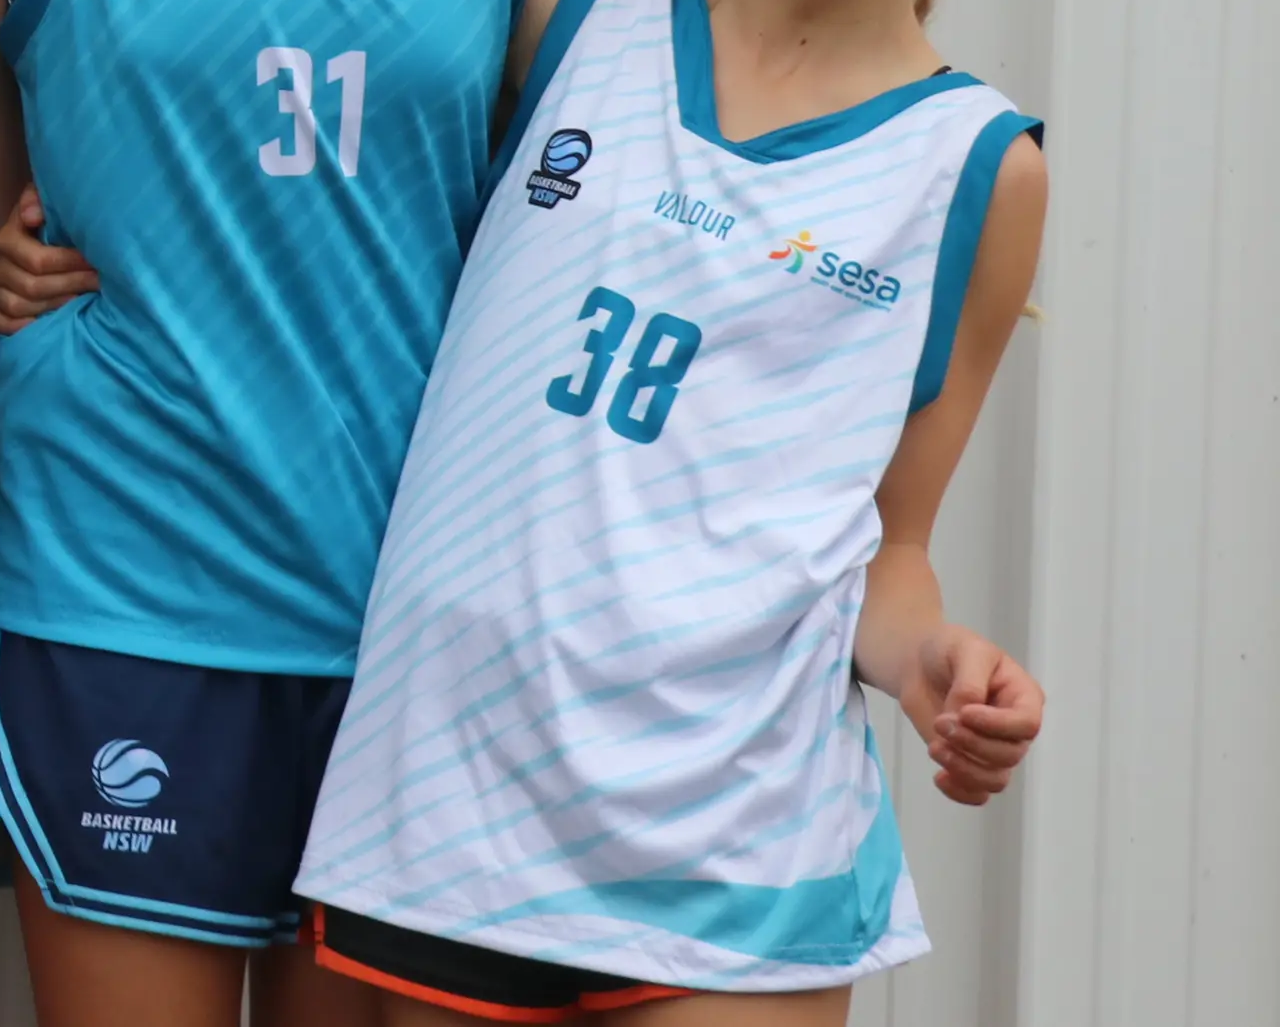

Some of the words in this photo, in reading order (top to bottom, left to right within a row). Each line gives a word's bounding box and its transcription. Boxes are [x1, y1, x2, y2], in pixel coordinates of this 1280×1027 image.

[256, 46, 367, 177] 31
[653, 190, 736, 241] VALOUR
[816, 251, 901, 304] sesa
[545, 286, 703, 444] 38
[81, 812, 178, 834] BASKETBALL
[102, 831, 153, 853] NSW
